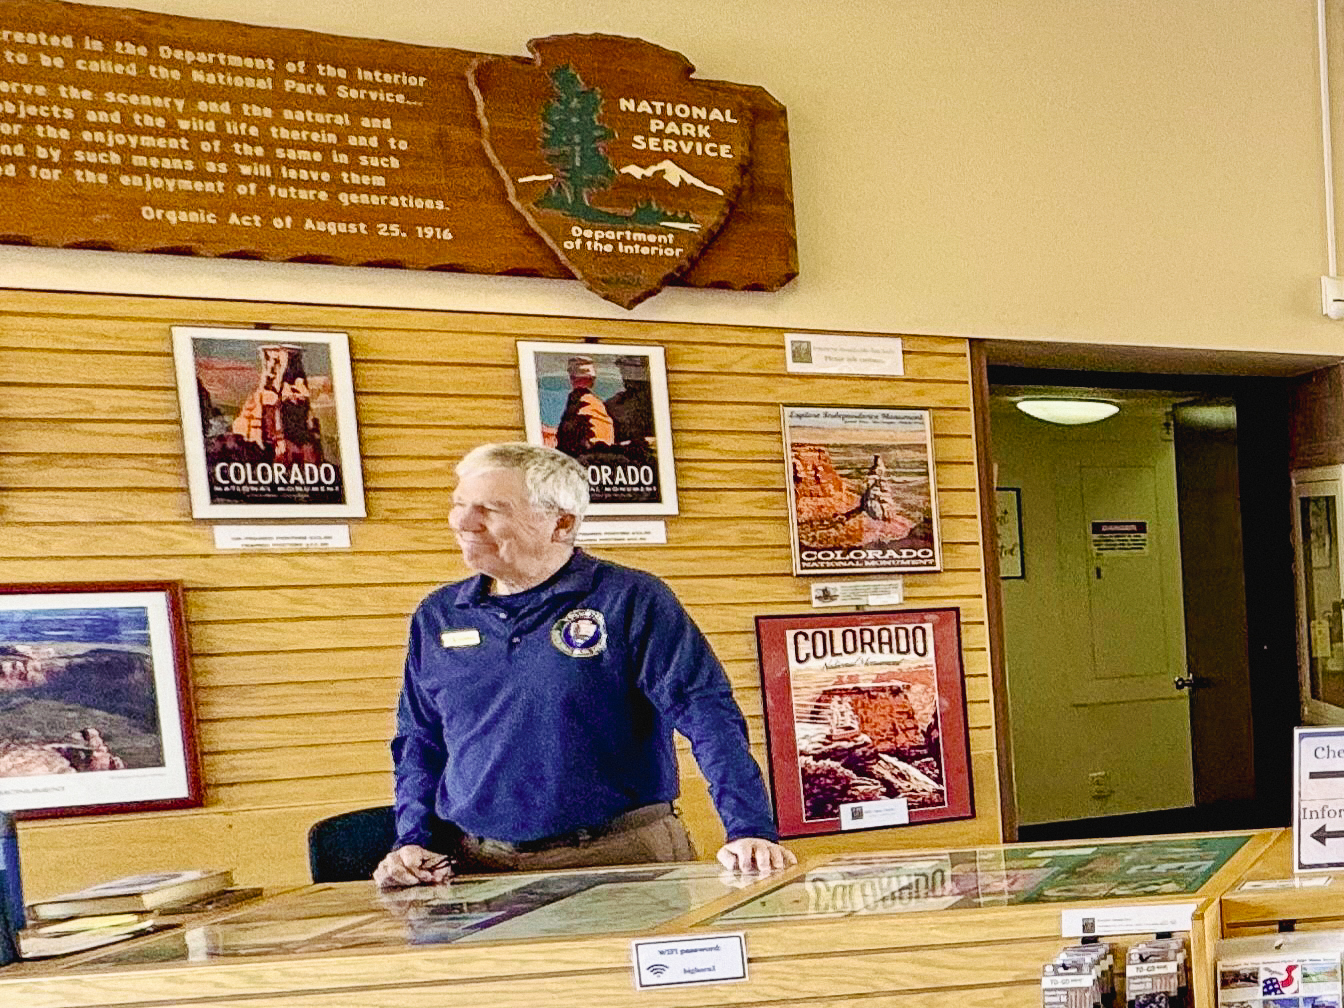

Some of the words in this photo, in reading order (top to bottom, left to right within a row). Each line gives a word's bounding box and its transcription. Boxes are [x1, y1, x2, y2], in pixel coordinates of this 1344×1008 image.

[0, 30, 73, 49] reated
[84, 36, 104, 52] in
[115, 40, 148, 57] the
[159, 45, 275, 71] Department
[285, 61, 306, 74] of
[317, 63, 347, 79] the
[357, 67, 427, 87] Interior
[4, 50, 29, 65] to
[40, 53, 64, 69] be
[76, 58, 137, 76] called
[149, 64, 181, 81] the
[192, 69, 273, 90] National
[284, 79, 327, 96] Park
[58, 85, 93, 101] the
[104, 91, 185, 113] scenery
[197, 100, 231, 115] and
[242, 104, 273, 118] the
[283, 109, 351, 126] natural
[360, 117, 392, 130] and
[619, 97, 738, 124] NATIONAL
[86, 110, 121, 124] and
[133, 112, 166, 129] the
[177, 117, 216, 133] wild
[225, 120, 259, 137] life
[270, 126, 338, 144] therein
[348, 135, 378, 148] and
[388, 137, 409, 150] to
[650, 119, 711, 138] PARK
[36, 124, 71, 140] the
[81, 130, 190, 151] enjoyment
[200, 140, 221, 153] of
[232, 142, 264, 157] the
[275, 148, 322, 162] same
[331, 150, 349, 164] in
[359, 155, 400, 169] such
[631, 135, 734, 158] SERVICE
[36, 145, 61, 163] by
[74, 150, 121, 165] such
[131, 154, 195, 171] means
[205, 161, 229, 174] as
[238, 163, 272, 177] will
[280, 166, 331, 183] leave
[341, 171, 386, 187] them
[29, 165, 63, 181] for
[74, 170, 109, 185] the
[119, 173, 225, 194] enjoyment
[236, 182, 257, 196] of
[268, 184, 329, 201] future
[337, 191, 451, 211] generations.
[141, 206, 217, 226] Organic
[228, 211, 262, 228] Act
[272, 215, 293, 229] of
[304, 218, 369, 236] August
[416, 225, 454, 241] 1916
[571, 226, 675, 244] Department
[563, 239, 582, 250] of
[586, 240, 614, 253] the
[618, 242, 683, 257] Interior
[822, 410, 880, 421] Independence
[881, 412, 924, 421] Monument
[214, 462, 336, 485] COLORADO
[588, 464, 654, 486] ORADO
[801, 548, 934, 561] COLORADO
[801, 560, 864, 568] NATIONAL
[864, 558, 935, 567] MONUMENT
[793, 625, 928, 664] COLORADO
